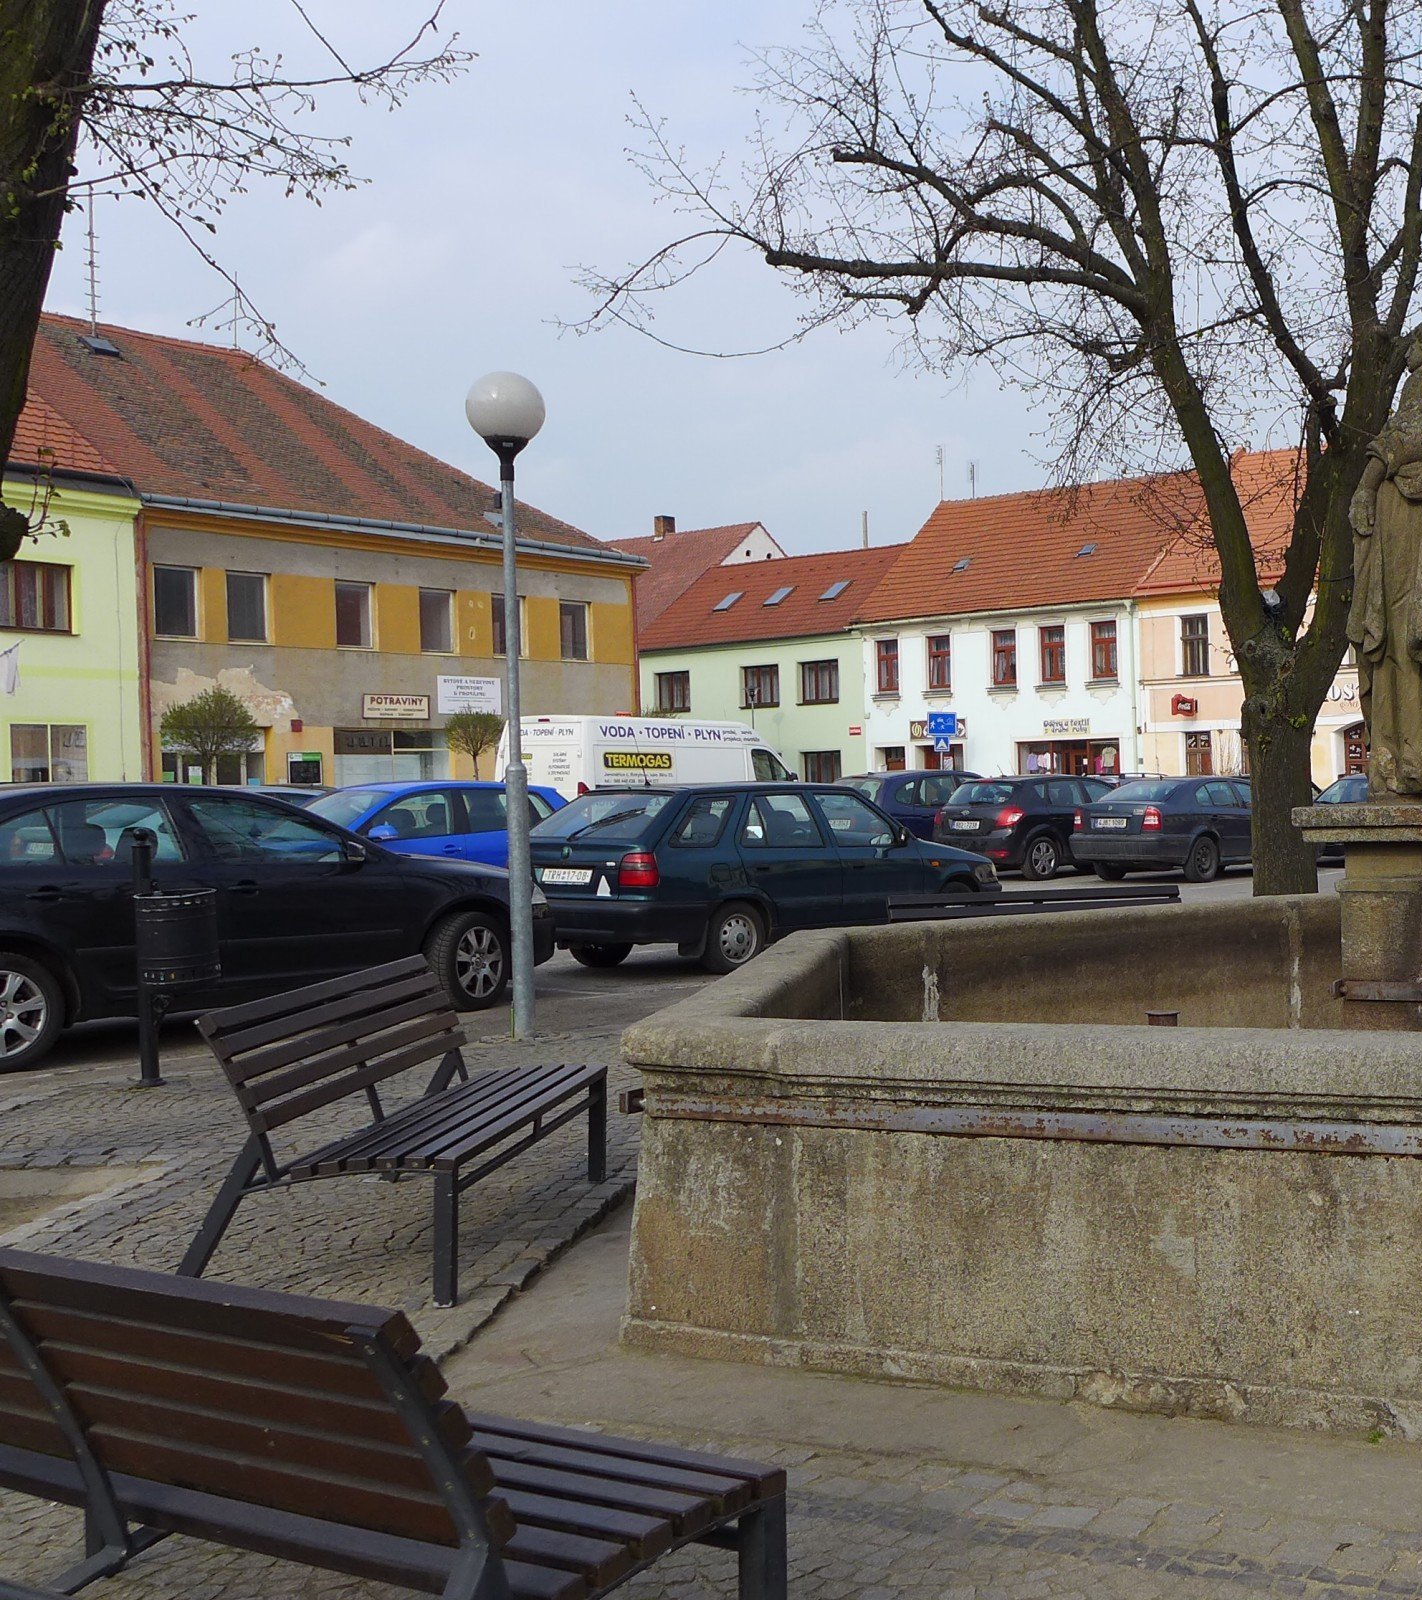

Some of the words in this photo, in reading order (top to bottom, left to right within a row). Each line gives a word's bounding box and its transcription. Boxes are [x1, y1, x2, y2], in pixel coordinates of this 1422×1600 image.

[370, 696, 424, 706] POTRAVINY
[600, 725, 635, 738] VODA
[644, 725, 685, 740] TOPENÍ
[695, 728, 722, 741] PLYN
[605, 754, 670, 768] TERMOGAS
[547, 870, 561, 880] TRH
